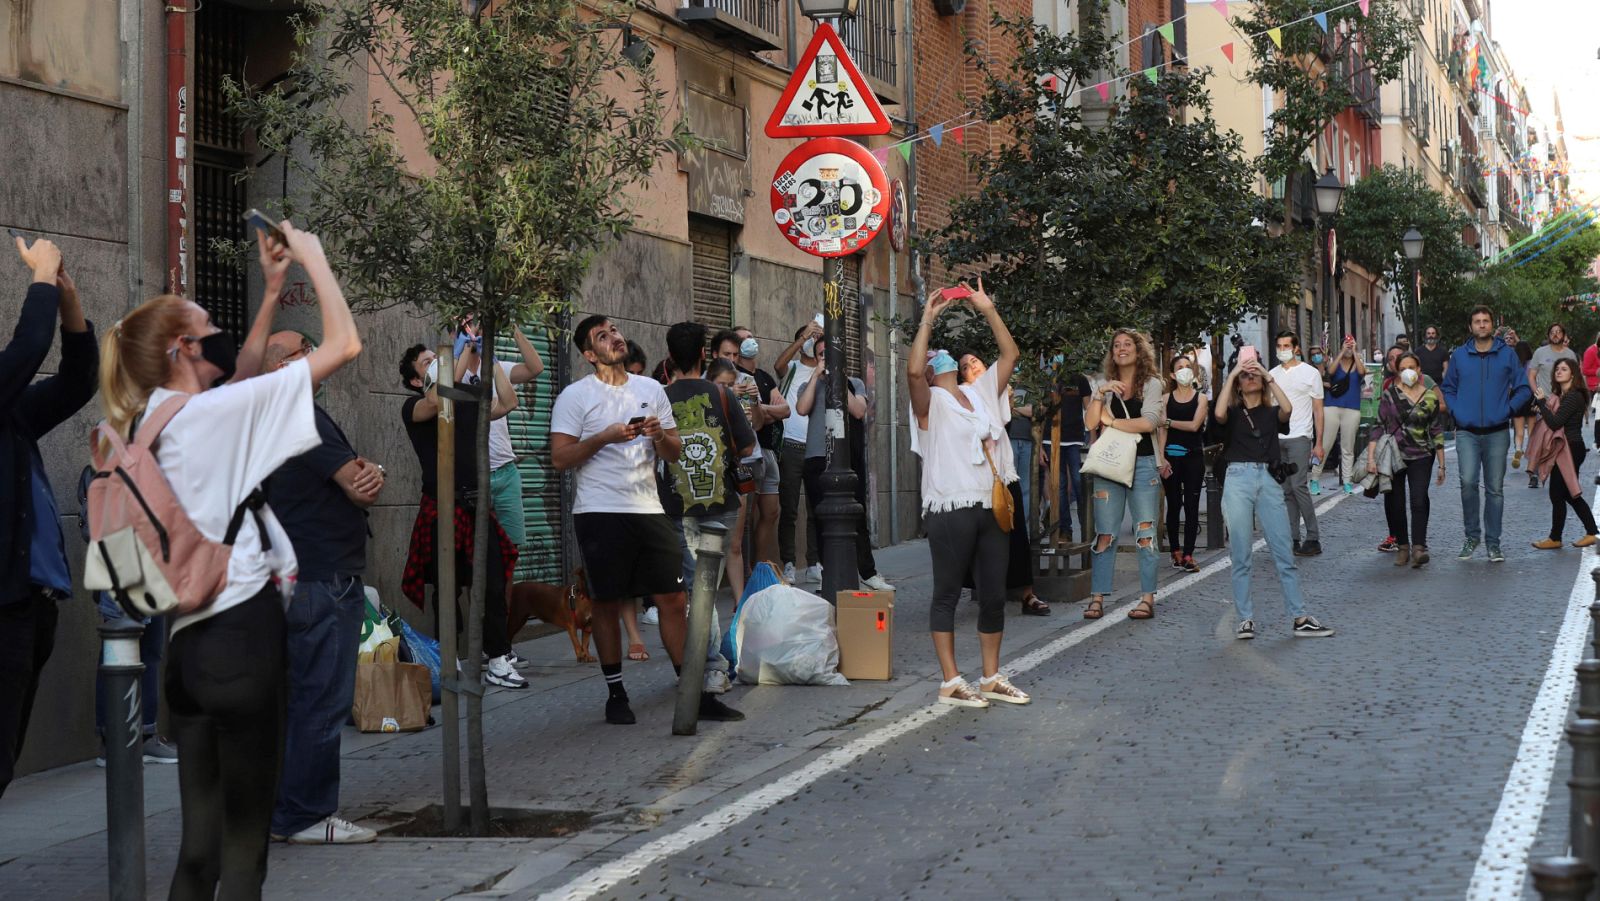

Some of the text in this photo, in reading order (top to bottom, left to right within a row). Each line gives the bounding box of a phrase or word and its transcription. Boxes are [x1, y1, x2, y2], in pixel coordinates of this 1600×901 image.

[774, 171, 792, 189] LOCOS
[778, 177, 797, 195] LOCOS
[798, 178, 863, 216] 20
[820, 203, 840, 217] 318
